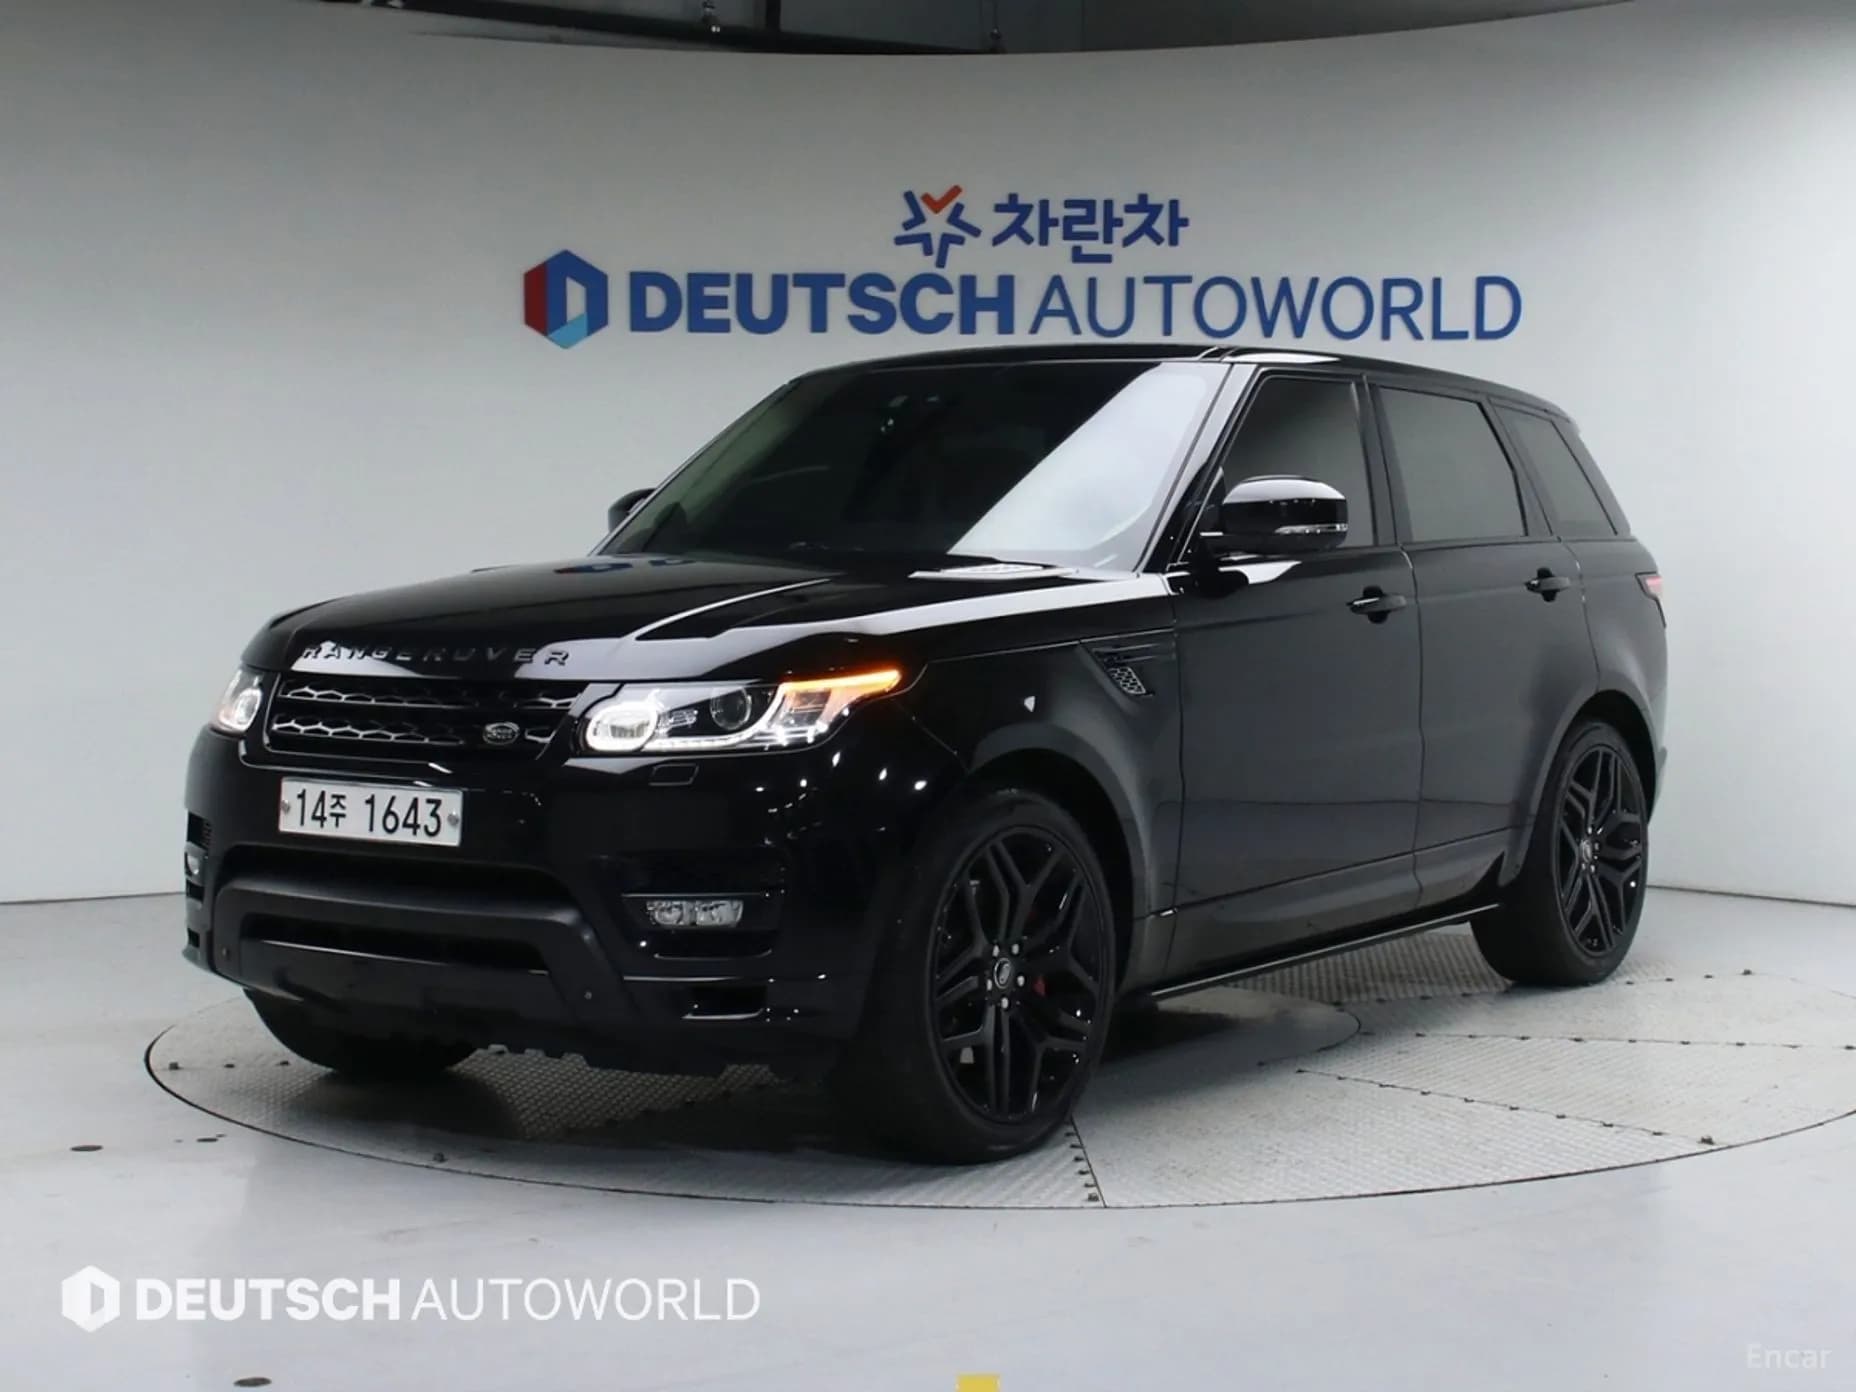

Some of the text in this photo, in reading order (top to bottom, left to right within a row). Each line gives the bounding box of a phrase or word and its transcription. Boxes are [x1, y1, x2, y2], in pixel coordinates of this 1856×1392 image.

[992, 194, 1190, 263] 차란차
[628, 271, 1526, 342] DEUTSCH AUTOWORLD
[296, 788, 443, 838] 14주 1643
